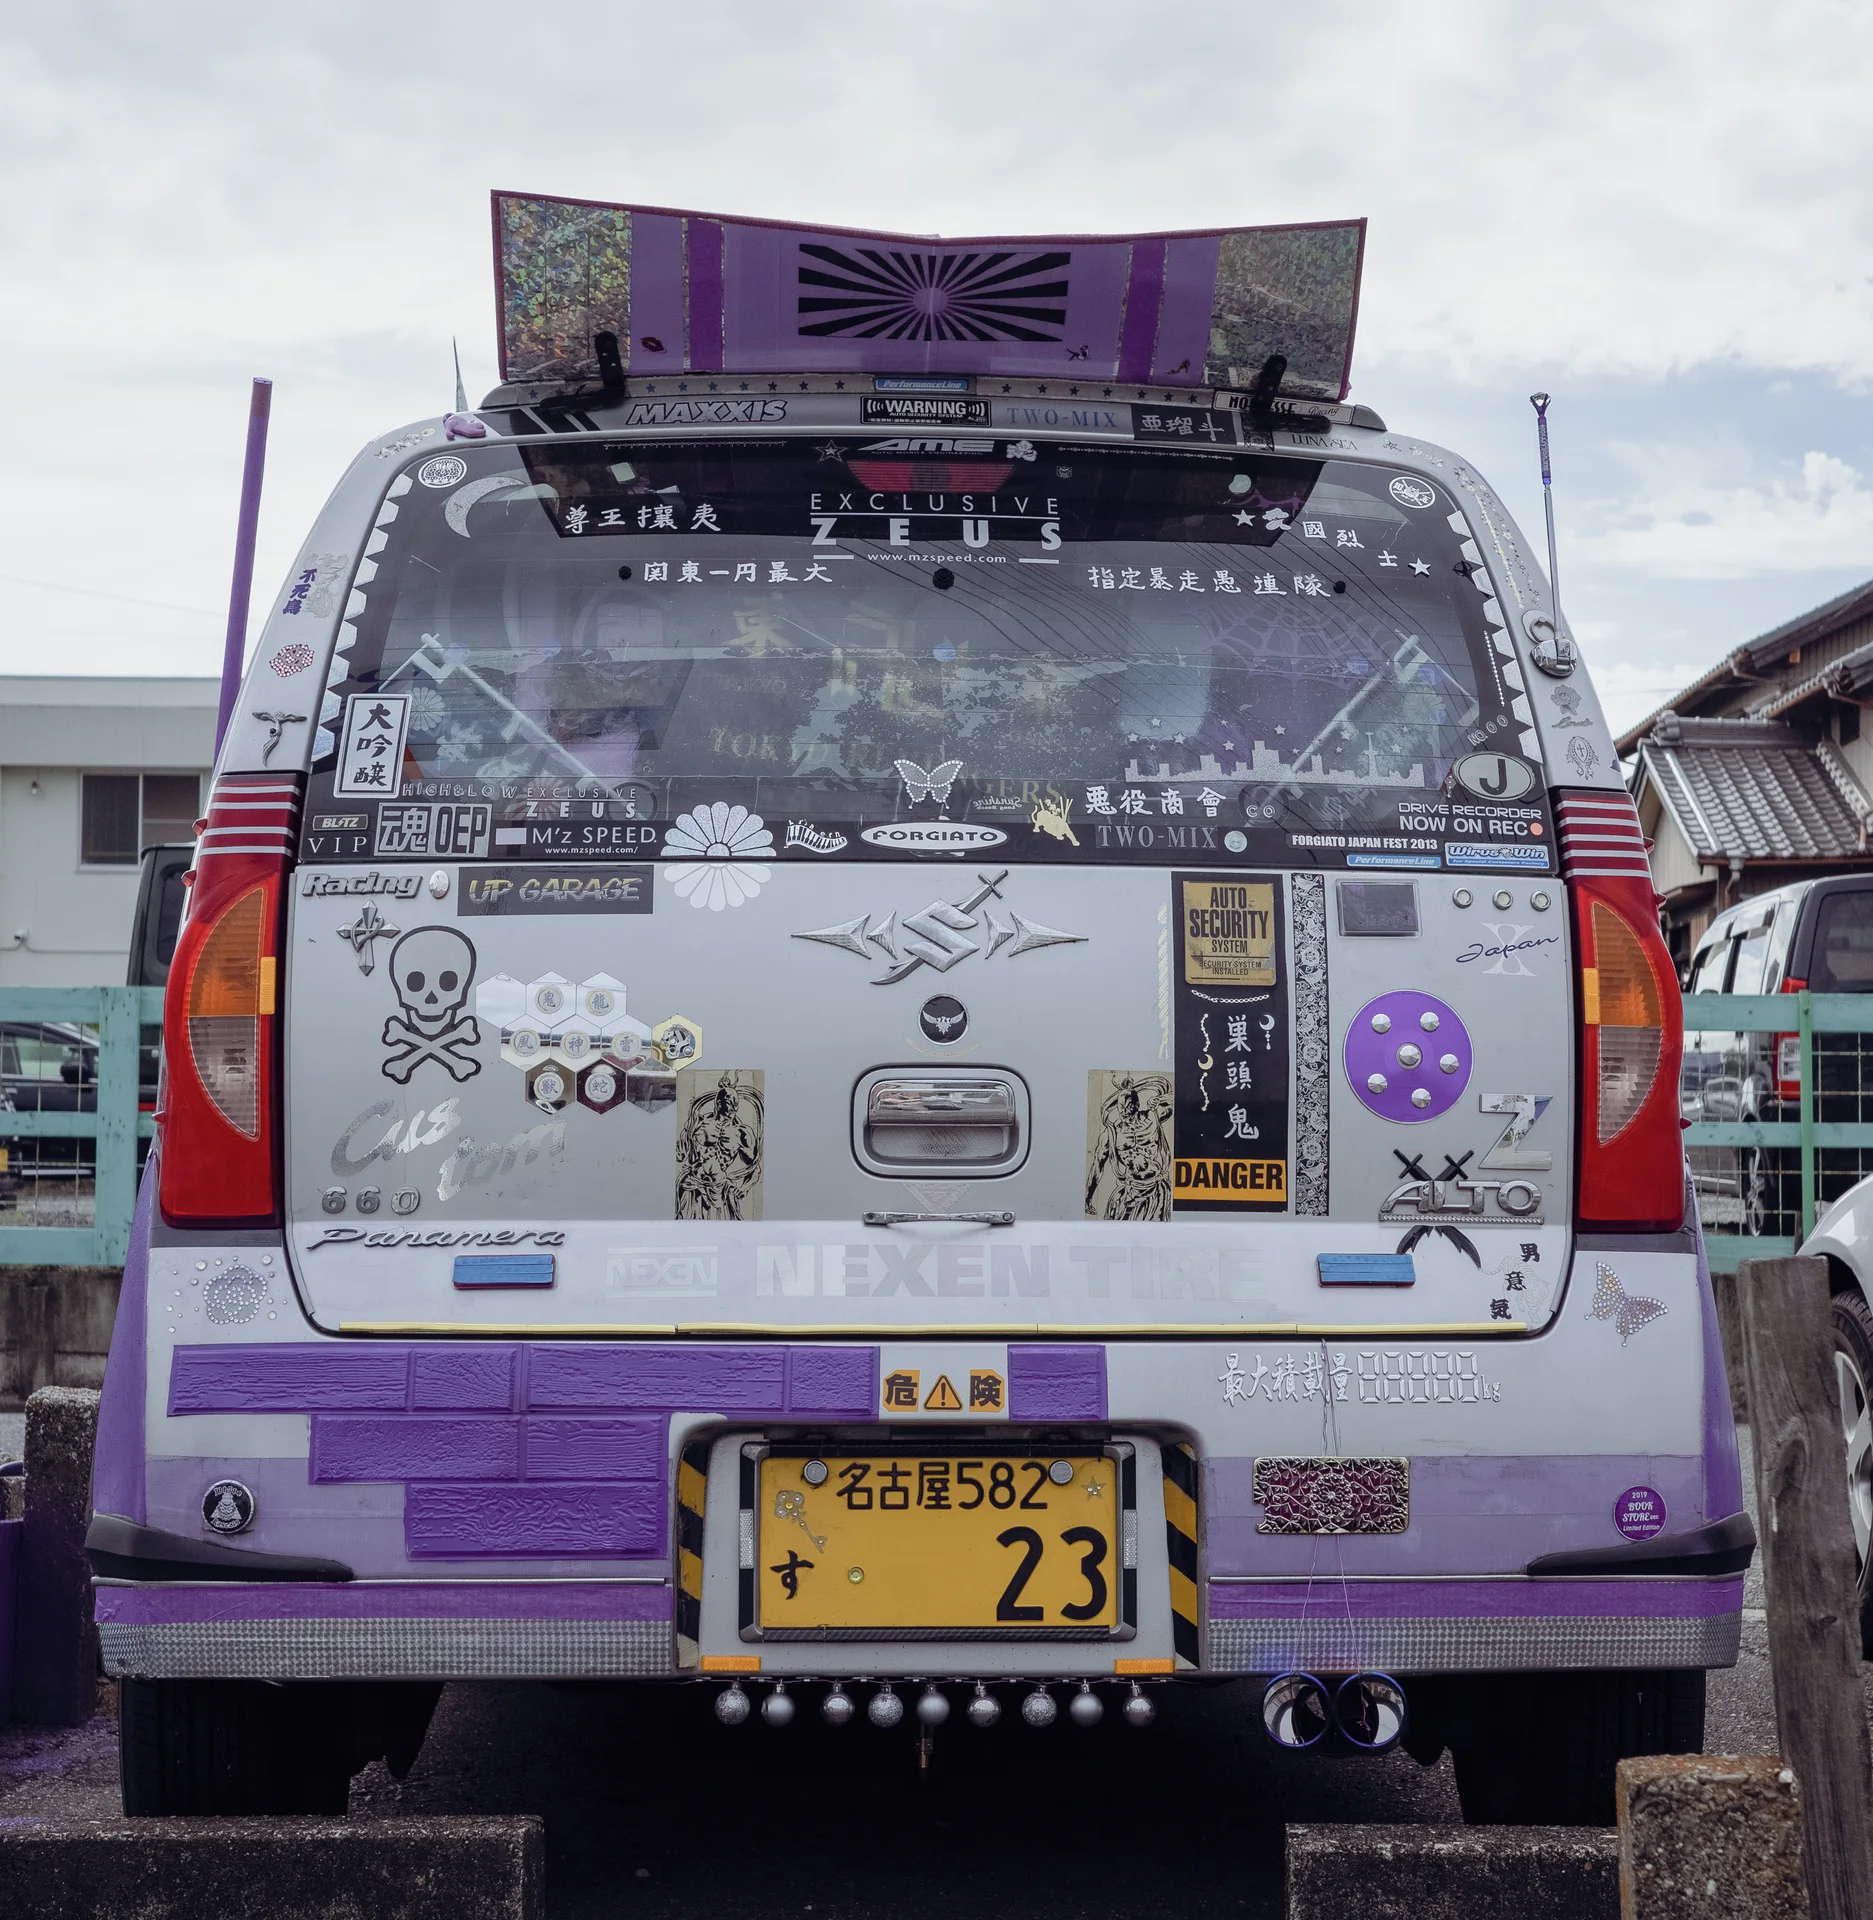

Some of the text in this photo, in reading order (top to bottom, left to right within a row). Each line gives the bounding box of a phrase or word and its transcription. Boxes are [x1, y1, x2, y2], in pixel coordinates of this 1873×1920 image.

[883, 380, 962, 390] PerformanceLine
[626, 399, 788, 426] MAXXIS
[885, 399, 967, 415] WARNING
[1007, 407, 1117, 428] TWO-MIX
[1291, 434, 1358, 451] LUNA SEA
[810, 493, 1058, 515] EXCLUSIVE
[565, 503, 721, 534] 尊王攘夷
[811, 517, 1062, 550] ZEUS
[867, 554, 1007, 564] www.mzspeed.com
[643, 560, 832, 583] 関東一円最大
[1088, 566, 1332, 597] 指定暴走愚連隊
[282, 569, 317, 615] 不死鳥
[1479, 758, 1507, 795] J
[527, 787, 636, 799] EXCLUSIVE
[1085, 785, 1226, 817] 悪役商會
[526, 801, 636, 819] ZEUS
[1398, 802, 1542, 820] DRIVE RECORDER
[321, 817, 359, 828] BLITZ
[1400, 816, 1528, 836] NOW ON REC
[308, 837, 367, 854] VIP
[872, 829, 997, 843] FORGIATO
[1098, 825, 1217, 848] TWO-MIX
[1292, 835, 1438, 850] FORGIATO JAPAN FEST 2013
[545, 846, 639, 856] www.mzspeed.com/
[1355, 855, 1436, 866] PerformanceLine
[1448, 845, 1546, 860] Wirus Win
[302, 872, 423, 899] Racing
[469, 877, 643, 904] UP GARAGE
[1210, 886, 1247, 909] AUTO
[1189, 908, 1269, 939] SECURITY
[1211, 939, 1248, 953] SYSTEM
[1456, 936, 1559, 963] Japan
[1212, 968, 1249, 976] INSTALLED
[1234, 961, 1262, 969] SYSTEM
[1224, 1014, 1259, 1139] 巣頭鬼
[1478, 1093, 1554, 1171] Z
[1175, 1161, 1284, 1190] DANGER
[321, 1185, 420, 1216] 660
[1379, 1180, 1542, 1216] ALTO
[306, 1226, 566, 1250] Panamera
[606, 1257, 718, 1286] NEXEN
[756, 1245, 1268, 1302] NEXEN TIRE
[885, 1370, 1004, 1408] 危 険
[1627, 1501, 1654, 1511] BOOK
[1631, 1491, 1648, 1499] 2019
[1622, 1512, 1650, 1523] STORE
[1623, 1524, 1642, 1532] Limited
[769, 1525, 1109, 1622] す 23
